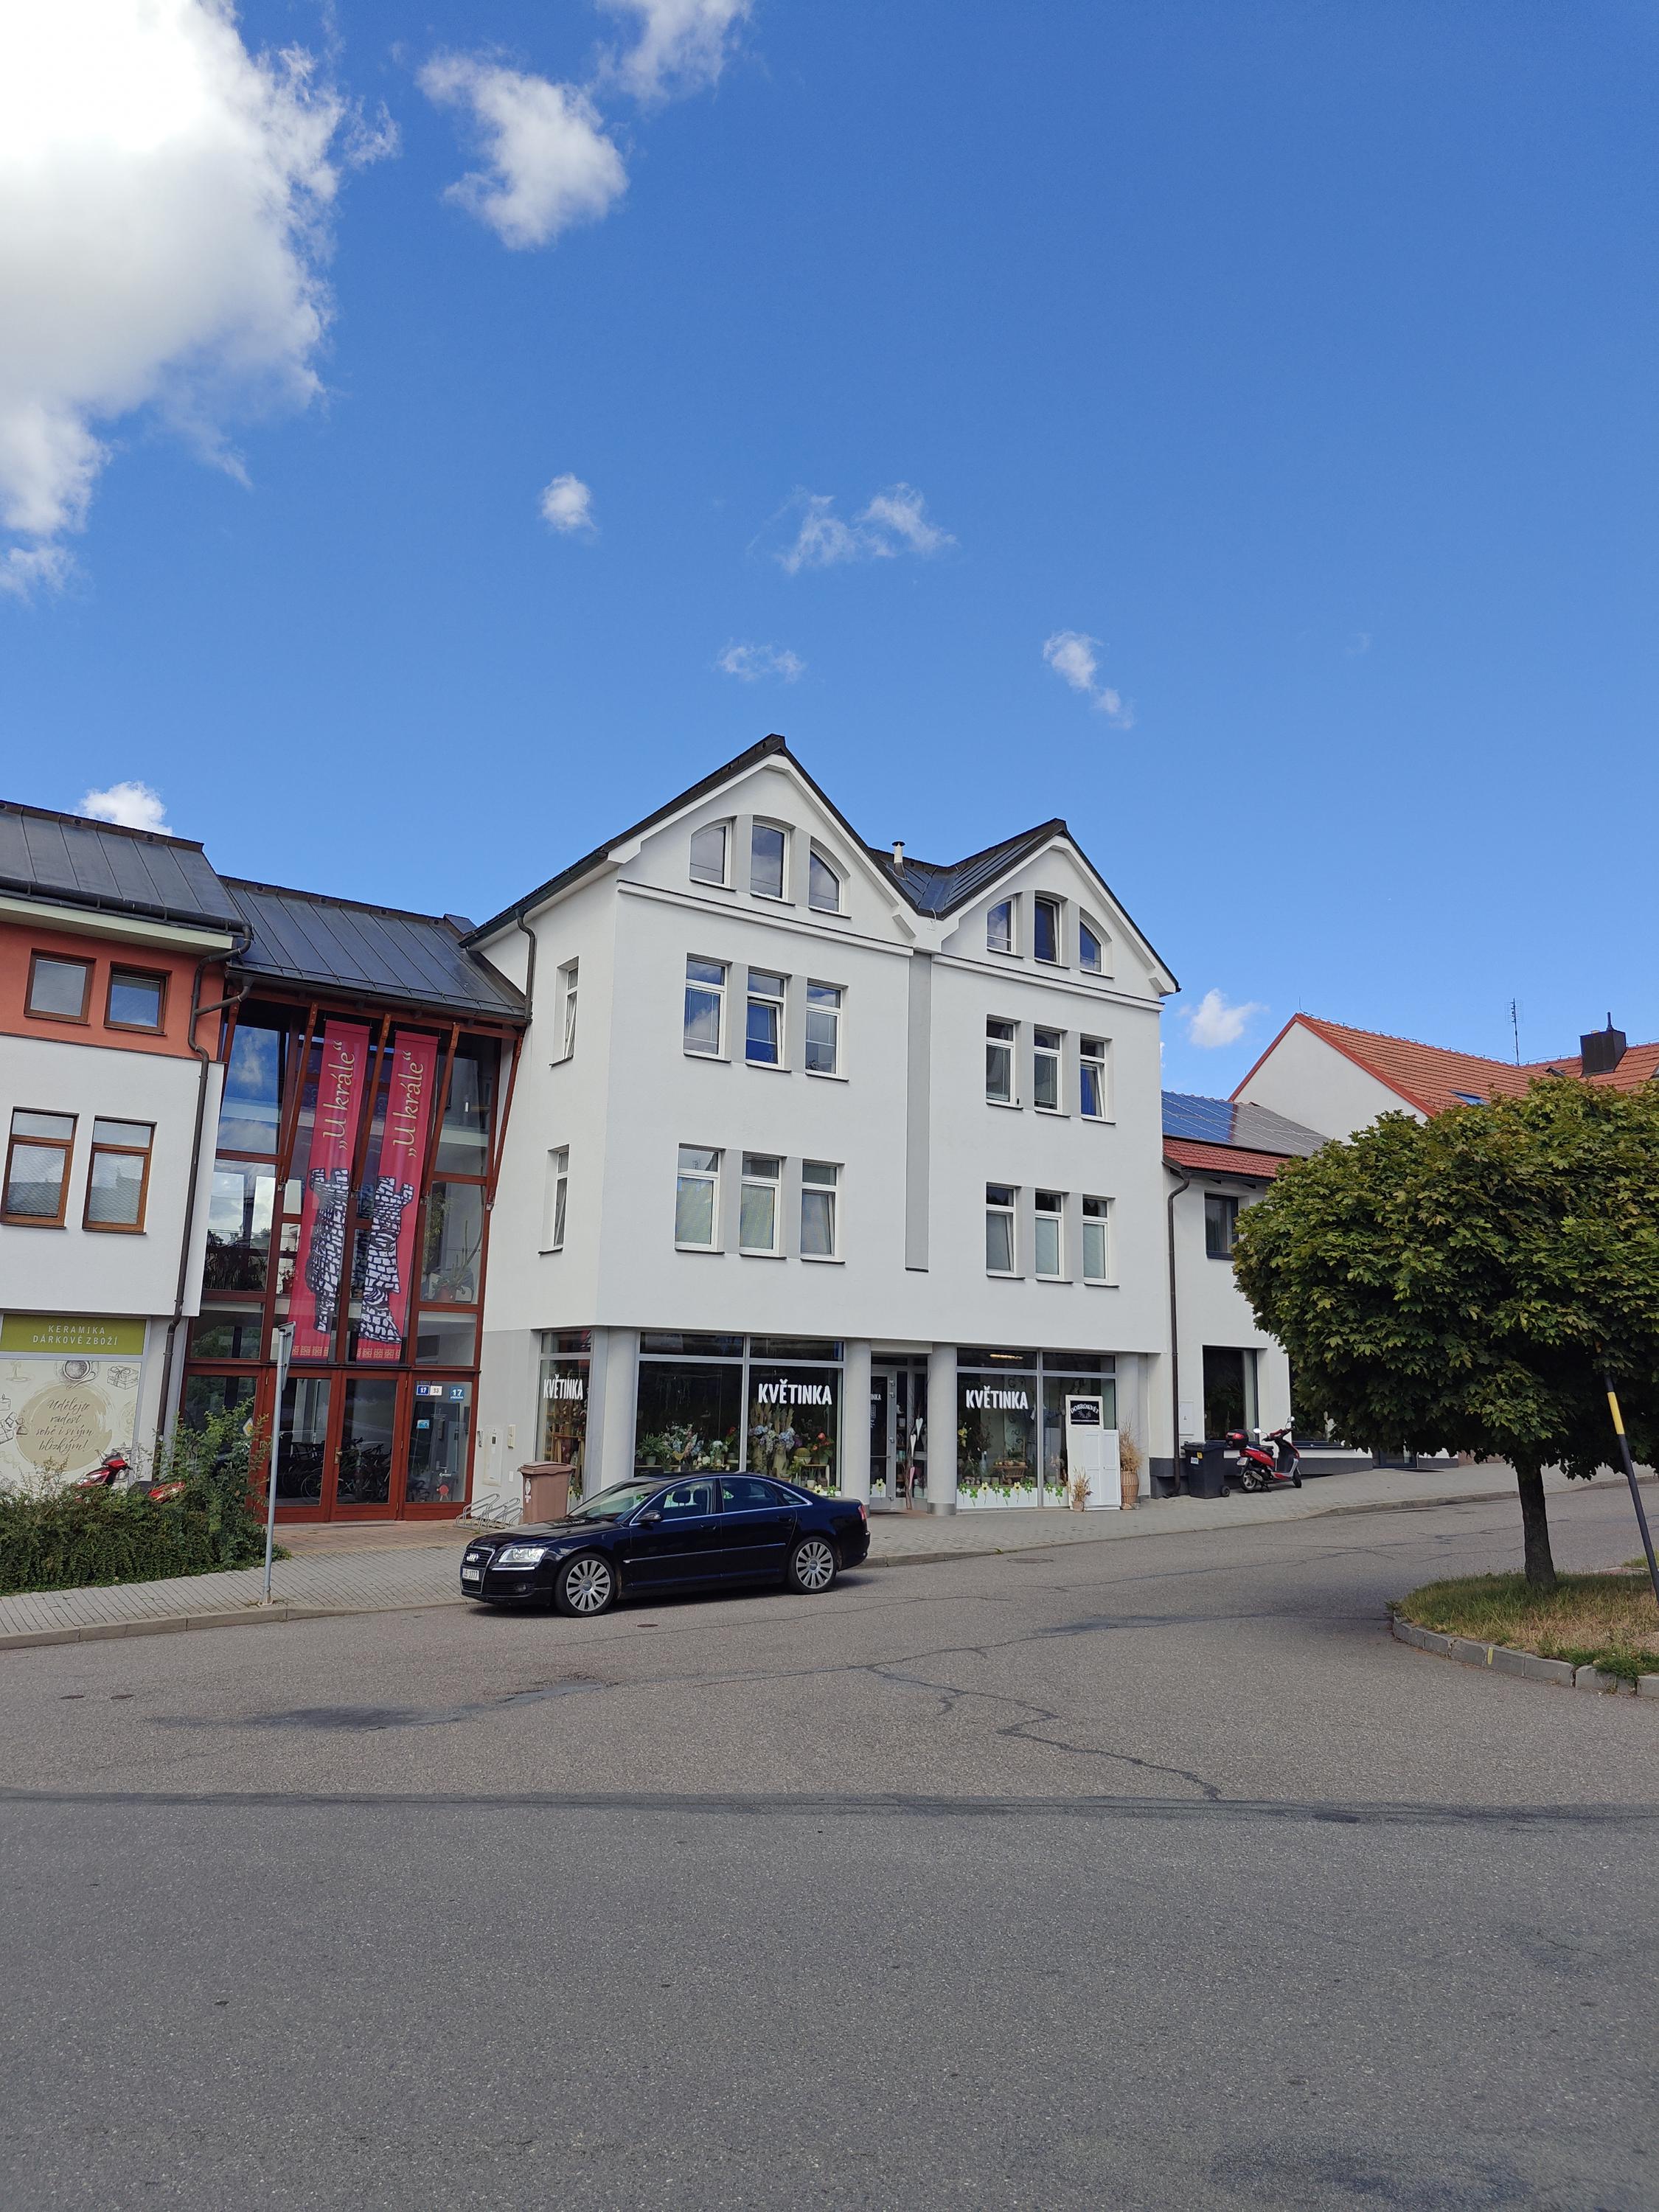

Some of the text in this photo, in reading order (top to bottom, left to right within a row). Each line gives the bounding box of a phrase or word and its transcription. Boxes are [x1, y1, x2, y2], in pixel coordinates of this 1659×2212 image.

[48, 1325, 105, 1334] KERAMIKA
[33, 1335, 118, 1346] DÁRKOVÉ ZBOŽÍ
[452, 1388, 462, 1397] 17
[543, 1373, 583, 1400] KVĚTINKA
[758, 1378, 832, 1405] KVĚTINKA
[966, 1385, 1029, 1409] KVĚTINKA
[50, 1412, 82, 1425] radost
